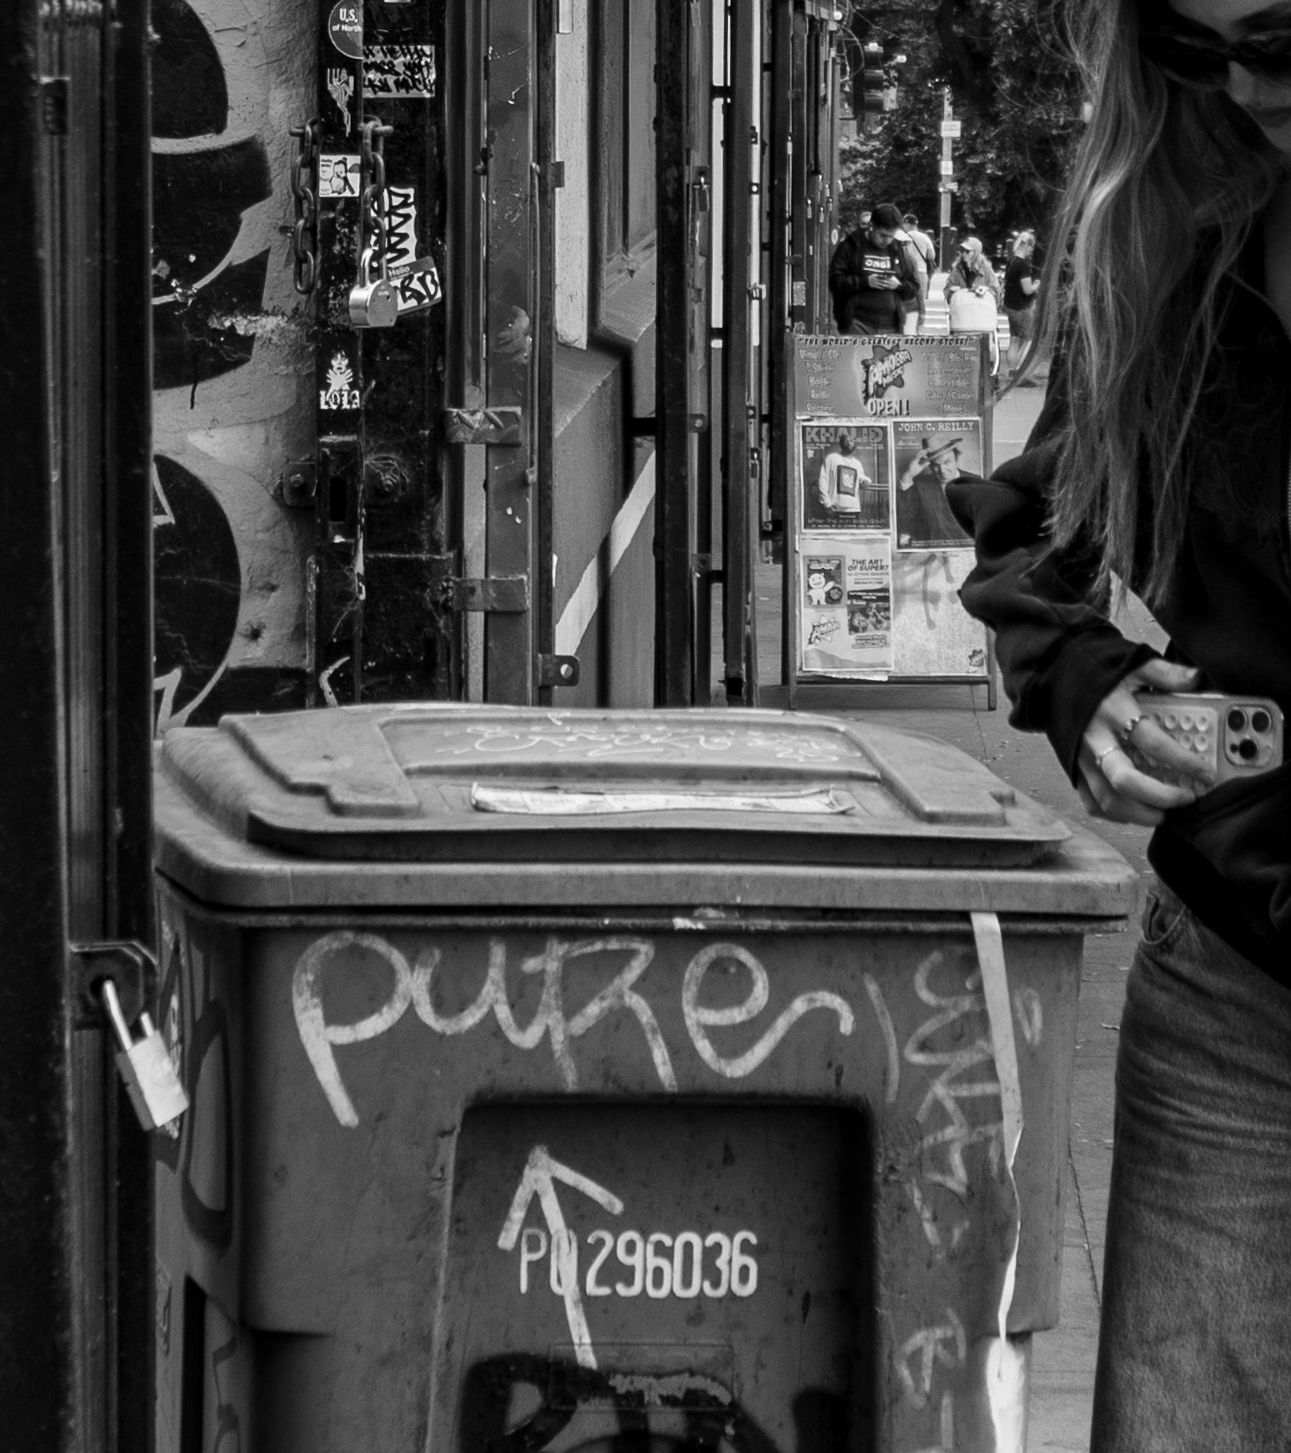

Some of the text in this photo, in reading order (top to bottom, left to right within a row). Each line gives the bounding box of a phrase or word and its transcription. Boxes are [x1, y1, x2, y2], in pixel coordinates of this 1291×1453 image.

[339, 8, 359, 23] U.S.
[332, 24, 362, 33] of North
[320, 389, 360, 410] LOLA
[868, 398, 910, 416] OPEN!
[898, 422, 975, 432] JOHN C. REILLY
[805, 427, 884, 443] KHALID
